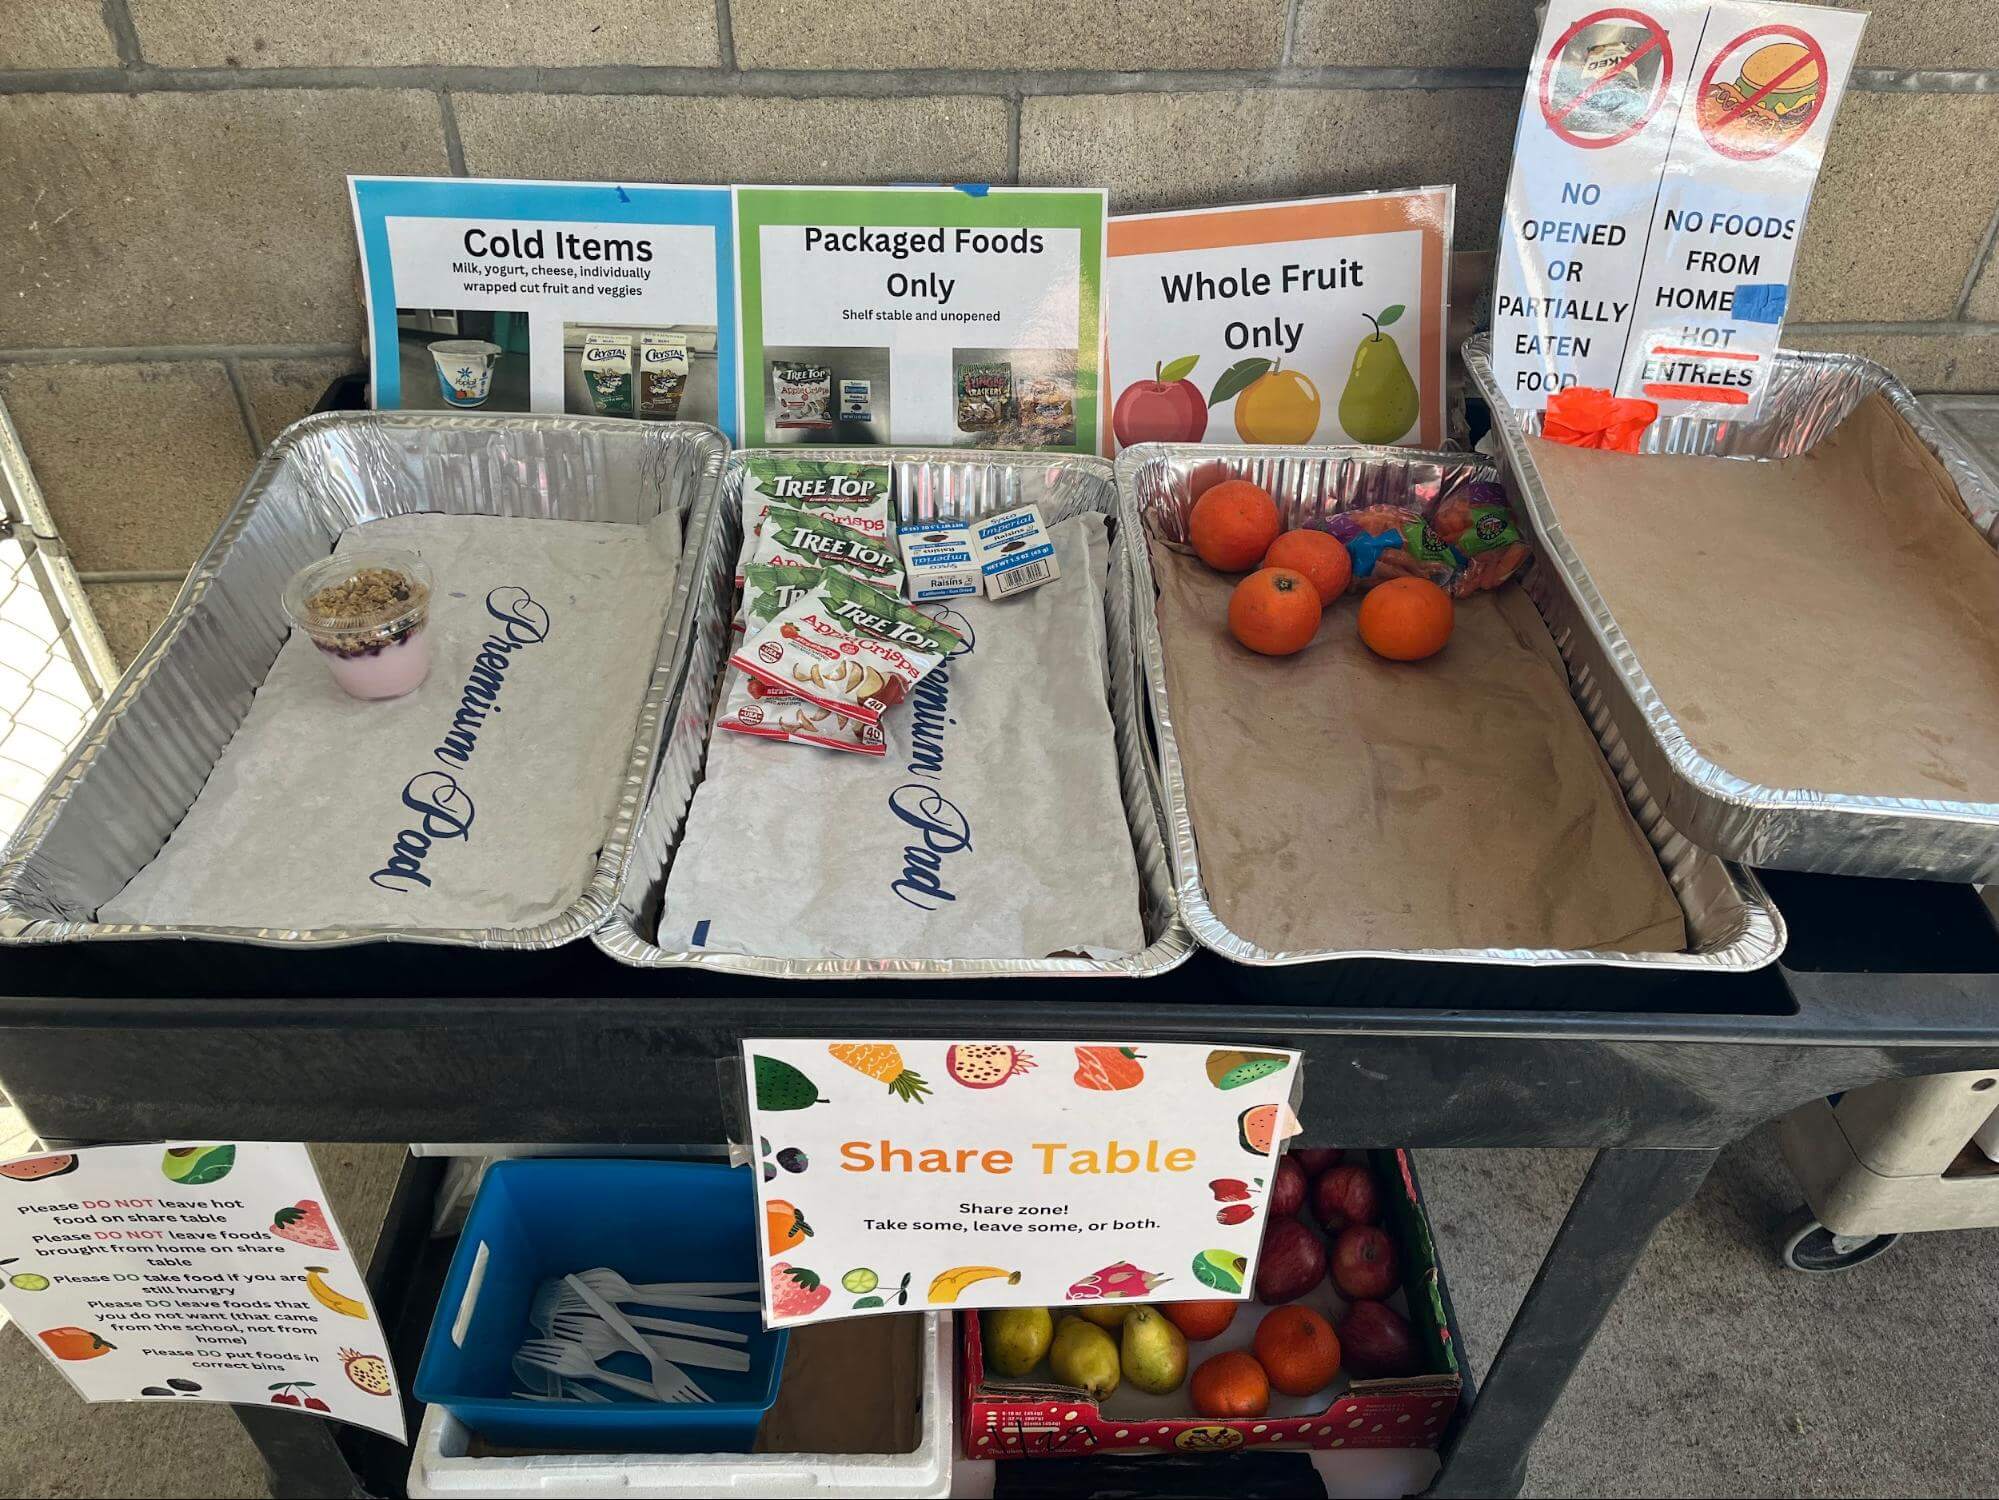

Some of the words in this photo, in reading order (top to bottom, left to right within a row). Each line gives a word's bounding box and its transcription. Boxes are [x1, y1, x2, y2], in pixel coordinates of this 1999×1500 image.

[1561, 182, 1601, 206] NO
[1521, 220, 1626, 246] OPENED
[1664, 209, 1703, 233] NO
[1710, 213, 1795, 240] FOODS
[464, 228, 545, 259] Cold
[557, 231, 654, 262] Items
[804, 227, 945, 259] Packaged
[954, 228, 1044, 254] Foods
[452, 262, 482, 277] Milk,
[484, 265, 529, 279] yogurt,
[531, 265, 578, 278] cheese,
[580, 266, 651, 280] individually
[1548, 260, 1583, 282] OR
[1686, 251, 1760, 276] FROM
[463, 282, 517, 296] wrapped
[520, 283, 540, 293] cut
[542, 282, 570, 294] fruit
[572, 283, 595, 295] and
[597, 284, 643, 299] veggies
[886, 272, 955, 304] Only
[1161, 267, 1271, 303] Whole
[1281, 259, 1364, 293] Fruit
[1498, 295, 1628, 323] PARTIALLY
[1655, 287, 1735, 312] HOME
[842, 309, 874, 321] Shelf
[875, 310, 913, 321] stable
[915, 310, 938, 321] and
[940, 310, 1001, 323] unopened
[1224, 317, 1304, 353] Only
[1516, 334, 1590, 357] EATEN
[1682, 326, 1736, 348] HOT
[587, 349, 626, 361] CRYSTAL
[645, 349, 685, 362] CRYSTAL
[1516, 371, 1578, 392] FOOD
[1641, 361, 1754, 387] ENTREES
[773, 475, 827, 499] TREE
[829, 475, 875, 497] TOP
[980, 514, 1032, 537] Imperial
[993, 527, 1025, 541] Raisins
[791, 527, 847, 554] TREE
[847, 540, 895, 567] TOP
[931, 578, 963, 588] Raisins
[834, 600, 891, 633] TREE
[888, 621, 939, 649] TOP
[800, 614, 858, 642] Apple
[859, 639, 920, 679] Crisps
[434, 586, 550, 770] Premium
[868, 700, 883, 711] 40
[866, 727, 880, 739] 40
[369, 770, 475, 893] Pad
[888, 783, 974, 911] Pad
[839, 1139, 1014, 1174] Share
[1031, 1139, 1198, 1175] Table
[17, 1202, 80, 1215] Please
[82, 1200, 111, 1209] DO
[113, 1199, 153, 1208] NOT
[158, 1199, 208, 1209] leave
[210, 1199, 245, 1209] hot
[959, 1203, 1014, 1215] Share
[1018, 1203, 1069, 1215] zone!
[53, 1214, 98, 1225] food
[101, 1214, 125, 1223] on
[128, 1213, 178, 1223] share
[180, 1213, 228, 1223] table
[863, 1219, 908, 1231] Take
[912, 1220, 968, 1233] some,
[973, 1220, 1023, 1232] leave
[1028, 1222, 1083, 1234] some,
[1088, 1222, 1108, 1232] or
[1113, 1218, 1161, 1231] both.
[32, 1232, 92, 1244] Please
[94, 1231, 122, 1240] DO
[126, 1230, 164, 1239] NOT
[168, 1230, 217, 1240] leave
[220, 1230, 272, 1240] foods
[35, 1244, 109, 1256] brought
[110, 1244, 154, 1253] from
[156, 1244, 206, 1253] home
[210, 1245, 233, 1253] on
[237, 1244, 286, 1253] share
[147, 1257, 193, 1267] table
[53, 1274, 111, 1283] Please
[113, 1273, 140, 1281] DO
[143, 1273, 181, 1282] take
[183, 1273, 224, 1282] food
[227, 1273, 240, 1282] if
[243, 1274, 276, 1284] you
[279, 1274, 308, 1282] are
[141, 1286, 175, 1294] still
[176, 1286, 235, 1296] hungry
[87, 1300, 143, 1308] Please
[174, 1300, 221, 1308] leave
[223, 1300, 272, 1309] foods
[274, 1300, 311, 1309] that
[94, 1313, 126, 1321] you
[154, 1312, 184, 1320] not
[230, 1312, 272, 1321] (that
[274, 1313, 319, 1322] came
[153, 1323, 183, 1331] the
[185, 1323, 244, 1333] school,
[247, 1325, 276, 1333] not
[277, 1325, 318, 1335] from
[195, 1334, 247, 1345] home)
[192, 1361, 250, 1369] correct
[251, 1362, 286, 1371] bins
[197, 1350, 222, 1358] DO
[226, 1351, 254, 1359] put
[256, 1351, 302, 1361] foods
[304, 1353, 320, 1363] in
